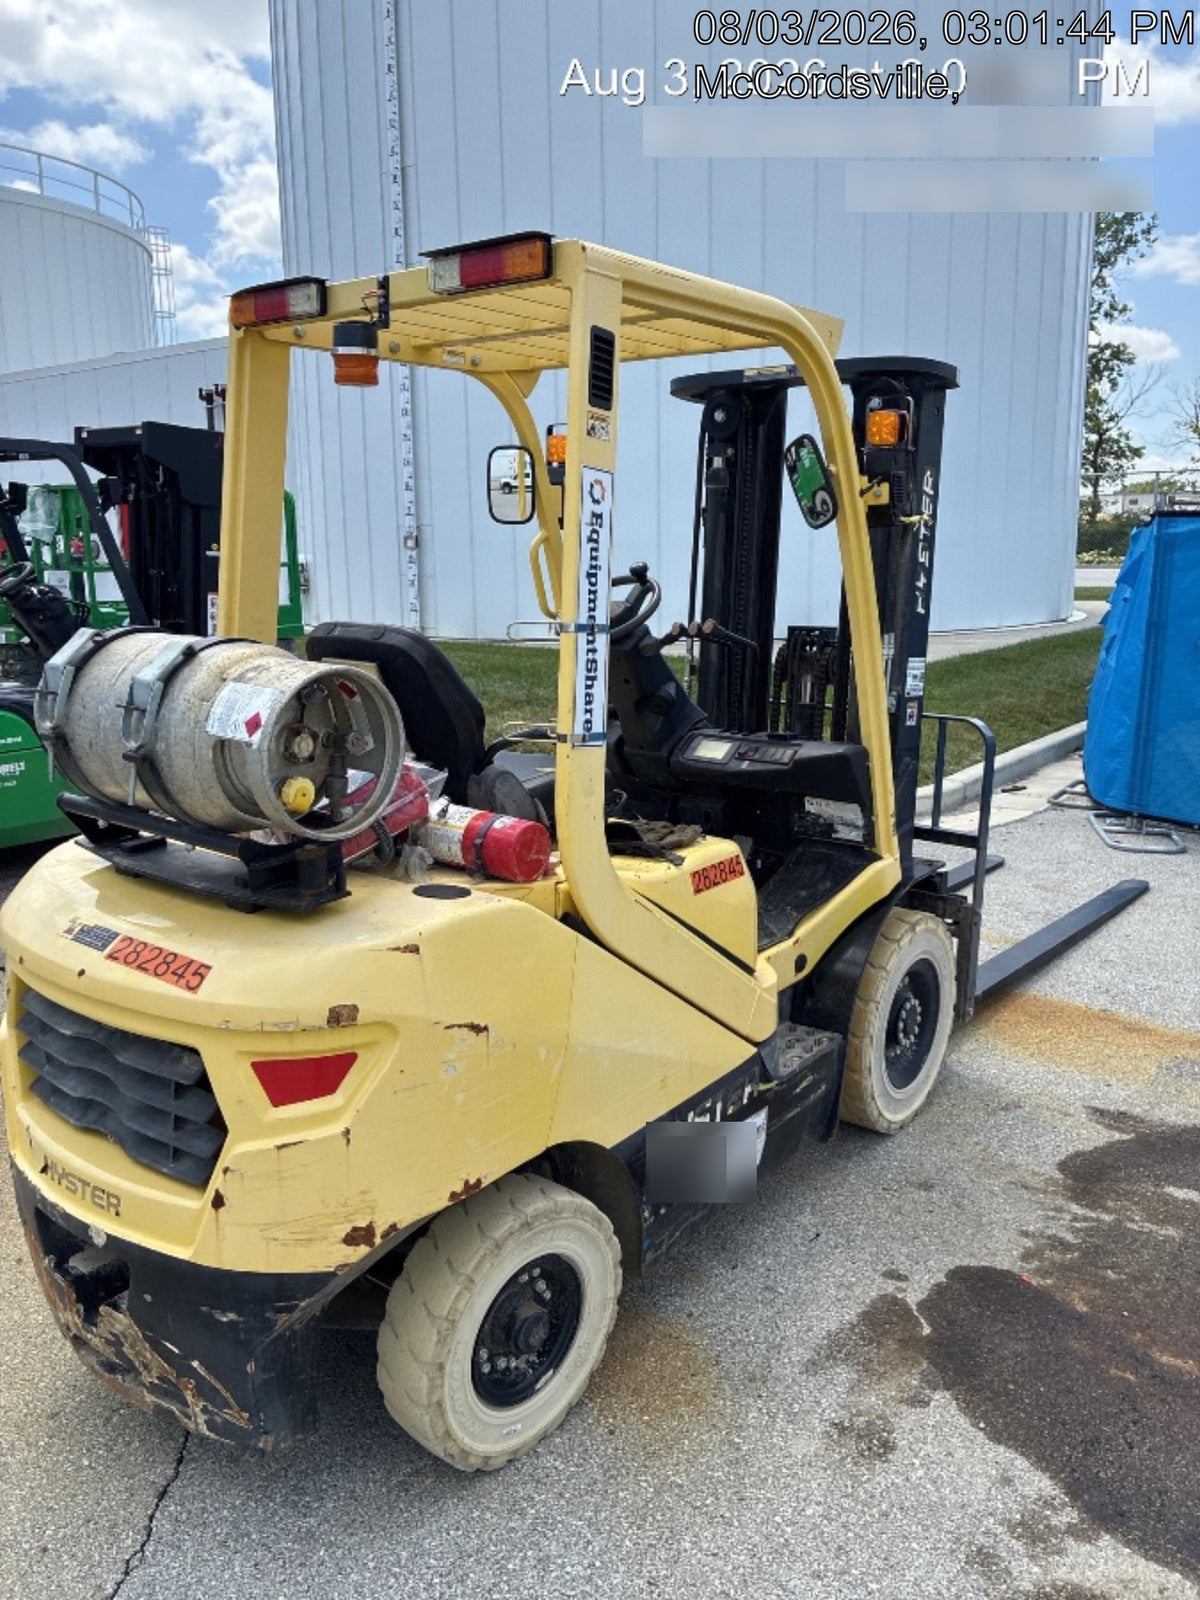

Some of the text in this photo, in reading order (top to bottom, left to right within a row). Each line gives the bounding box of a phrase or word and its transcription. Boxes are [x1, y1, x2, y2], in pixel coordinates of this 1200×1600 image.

[582, 510, 604, 734] EquipmentShare
[107, 935, 213, 992] 282845
[39, 1154, 122, 1217] HYSTER
